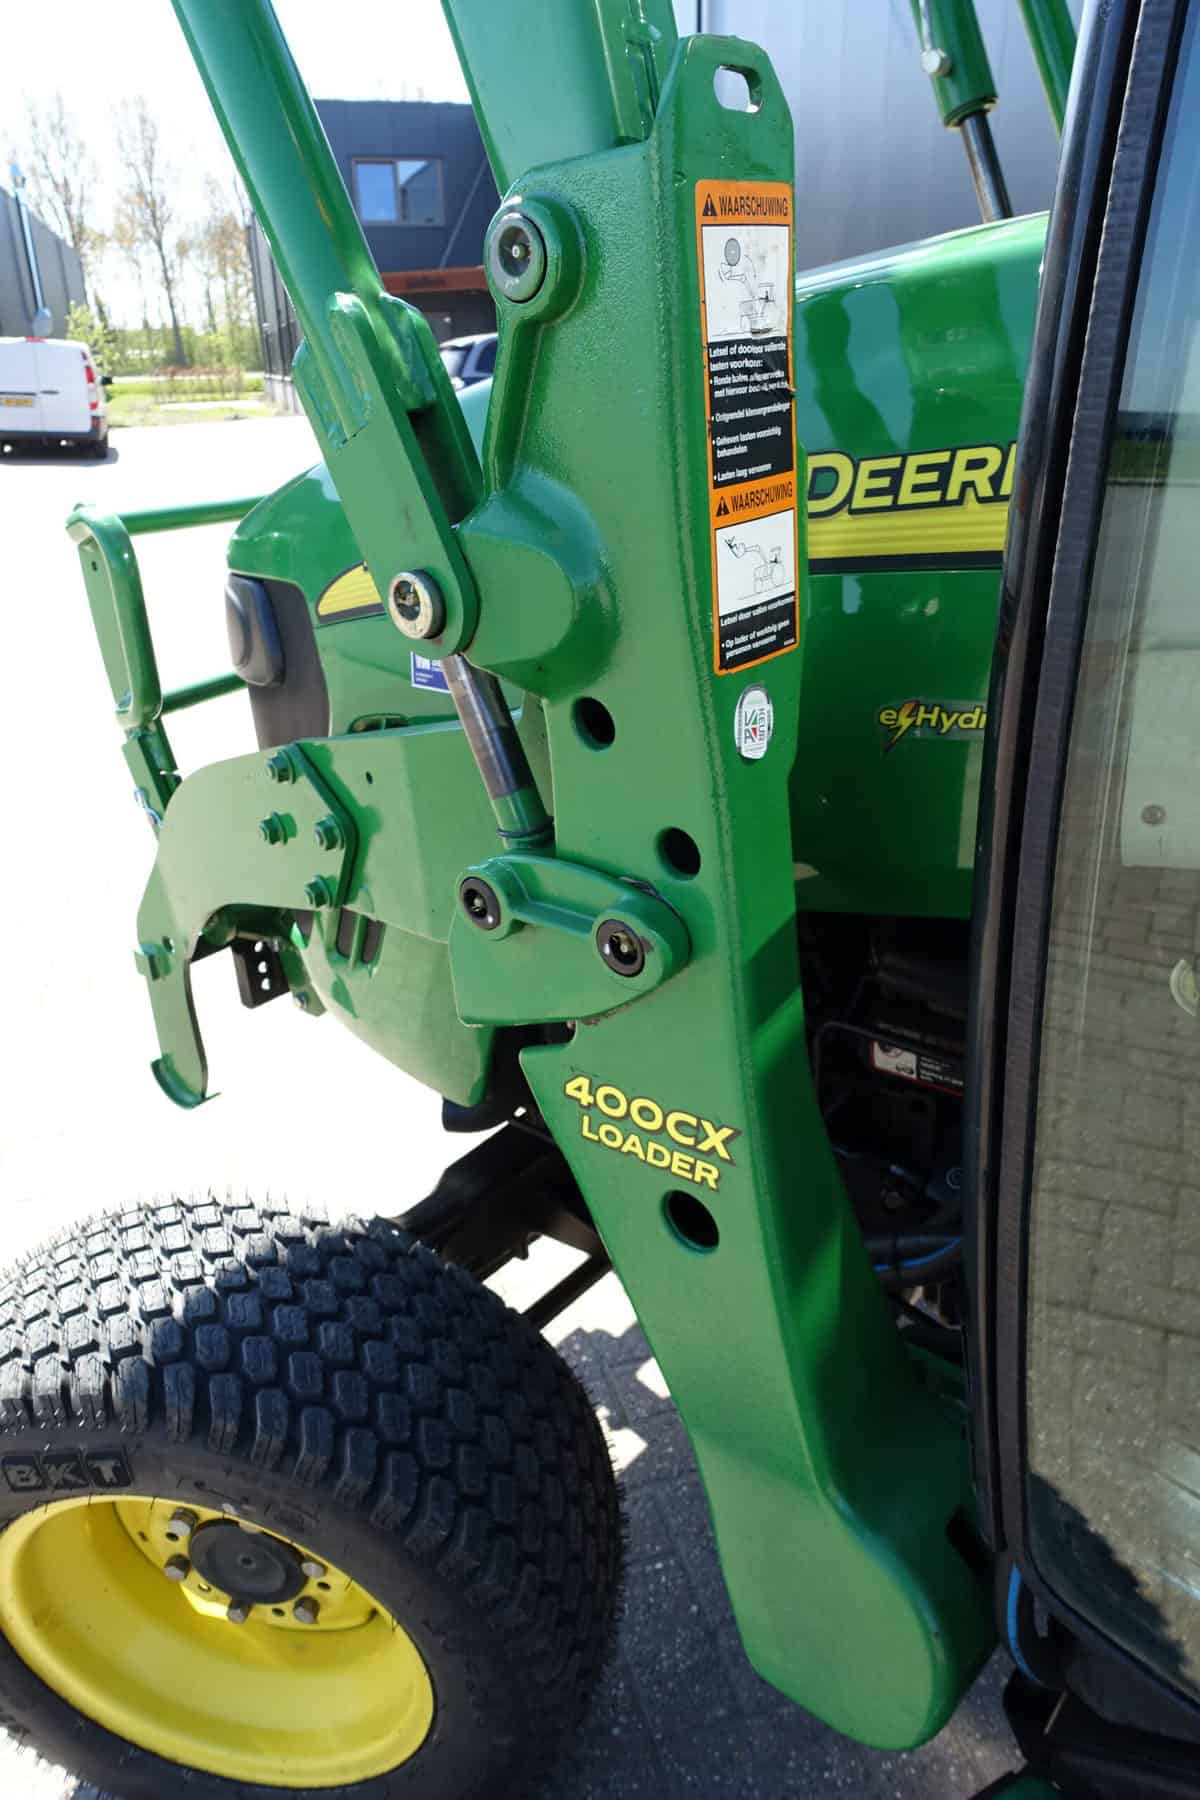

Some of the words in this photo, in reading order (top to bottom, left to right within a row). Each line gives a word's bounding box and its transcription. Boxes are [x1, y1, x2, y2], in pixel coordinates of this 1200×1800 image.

[719, 195, 788, 216] WAARSCHUWING
[729, 344, 737, 355] of
[731, 481, 793, 513] WAARSCHUWING
[725, 639, 734, 648] Op
[564, 1074, 737, 1163] 400CX
[582, 1114, 720, 1190] LOADER
[3, 1456, 124, 1490] BKT
